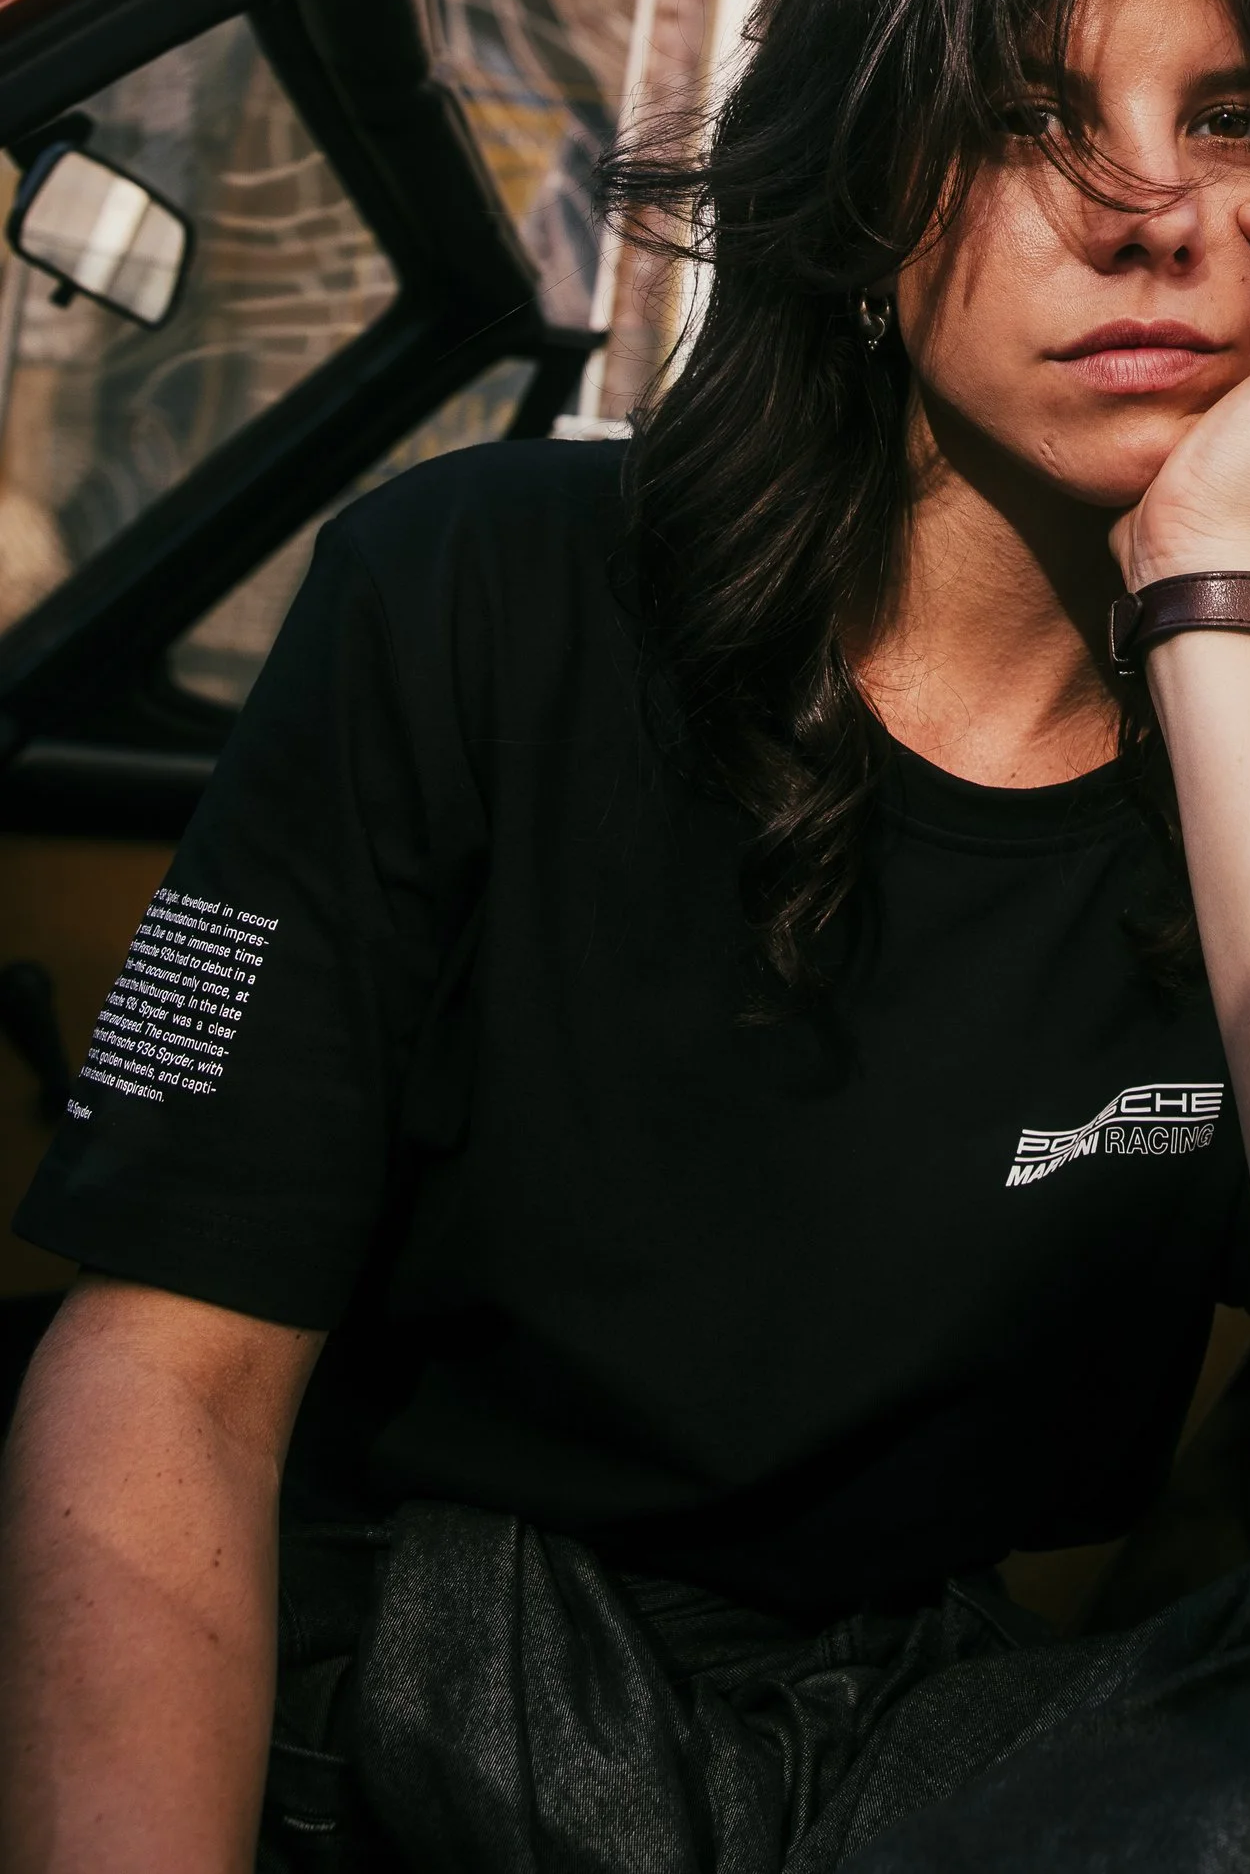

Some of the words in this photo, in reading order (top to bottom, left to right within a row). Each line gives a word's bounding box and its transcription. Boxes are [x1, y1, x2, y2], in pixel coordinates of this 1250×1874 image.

[164, 908, 198, 928] foundation
[197, 918, 210, 931] for
[210, 923, 221, 935] an
[223, 924, 269, 947] impres-
[181, 894, 221, 914] developed
[222, 904, 234, 918] in
[237, 911, 279, 931] record
[152, 925, 166, 939] Due
[166, 930, 174, 941] to
[174, 931, 187, 945] the
[187, 935, 231, 957] immense
[234, 948, 263, 967] time
[159, 946, 175, 961] 936
[174, 950, 191, 966] had
[189, 956, 201, 969] to
[202, 960, 233, 978] debut
[233, 968, 245, 982] in
[247, 974, 256, 985] a
[145, 965, 182, 984] occurred
[182, 976, 200, 992] only
[202, 981, 230, 999] once,
[236, 991, 250, 1003] at
[125, 996, 139, 1011] 936
[138, 1000, 170, 1021] Spyder
[172, 1013, 192, 1028] was
[196, 1020, 203, 1031] a
[208, 1022, 237, 1040] clear
[188, 995, 198, 1009] In
[200, 999, 217, 1015] the
[219, 1003, 242, 1021] late
[106, 1030, 136, 1051] Porsche
[136, 1040, 157, 1057] 936
[156, 1046, 195, 1071] Spyder,
[198, 1060, 224, 1077] with
[109, 1014, 125, 1026] and
[120, 1020, 144, 1033] speed.
[145, 1022, 162, 1039] The
[162, 1030, 230, 1057] communica-
[99, 1051, 123, 1067] golden
[123, 1059, 156, 1080] wheels,
[158, 1070, 181, 1085] and
[181, 1077, 217, 1095] capti-
[115, 1074, 165, 1102] inspiration.
[1005, 1130, 1100, 1187] MARTINI
[1105, 1124, 1215, 1155] RACING
